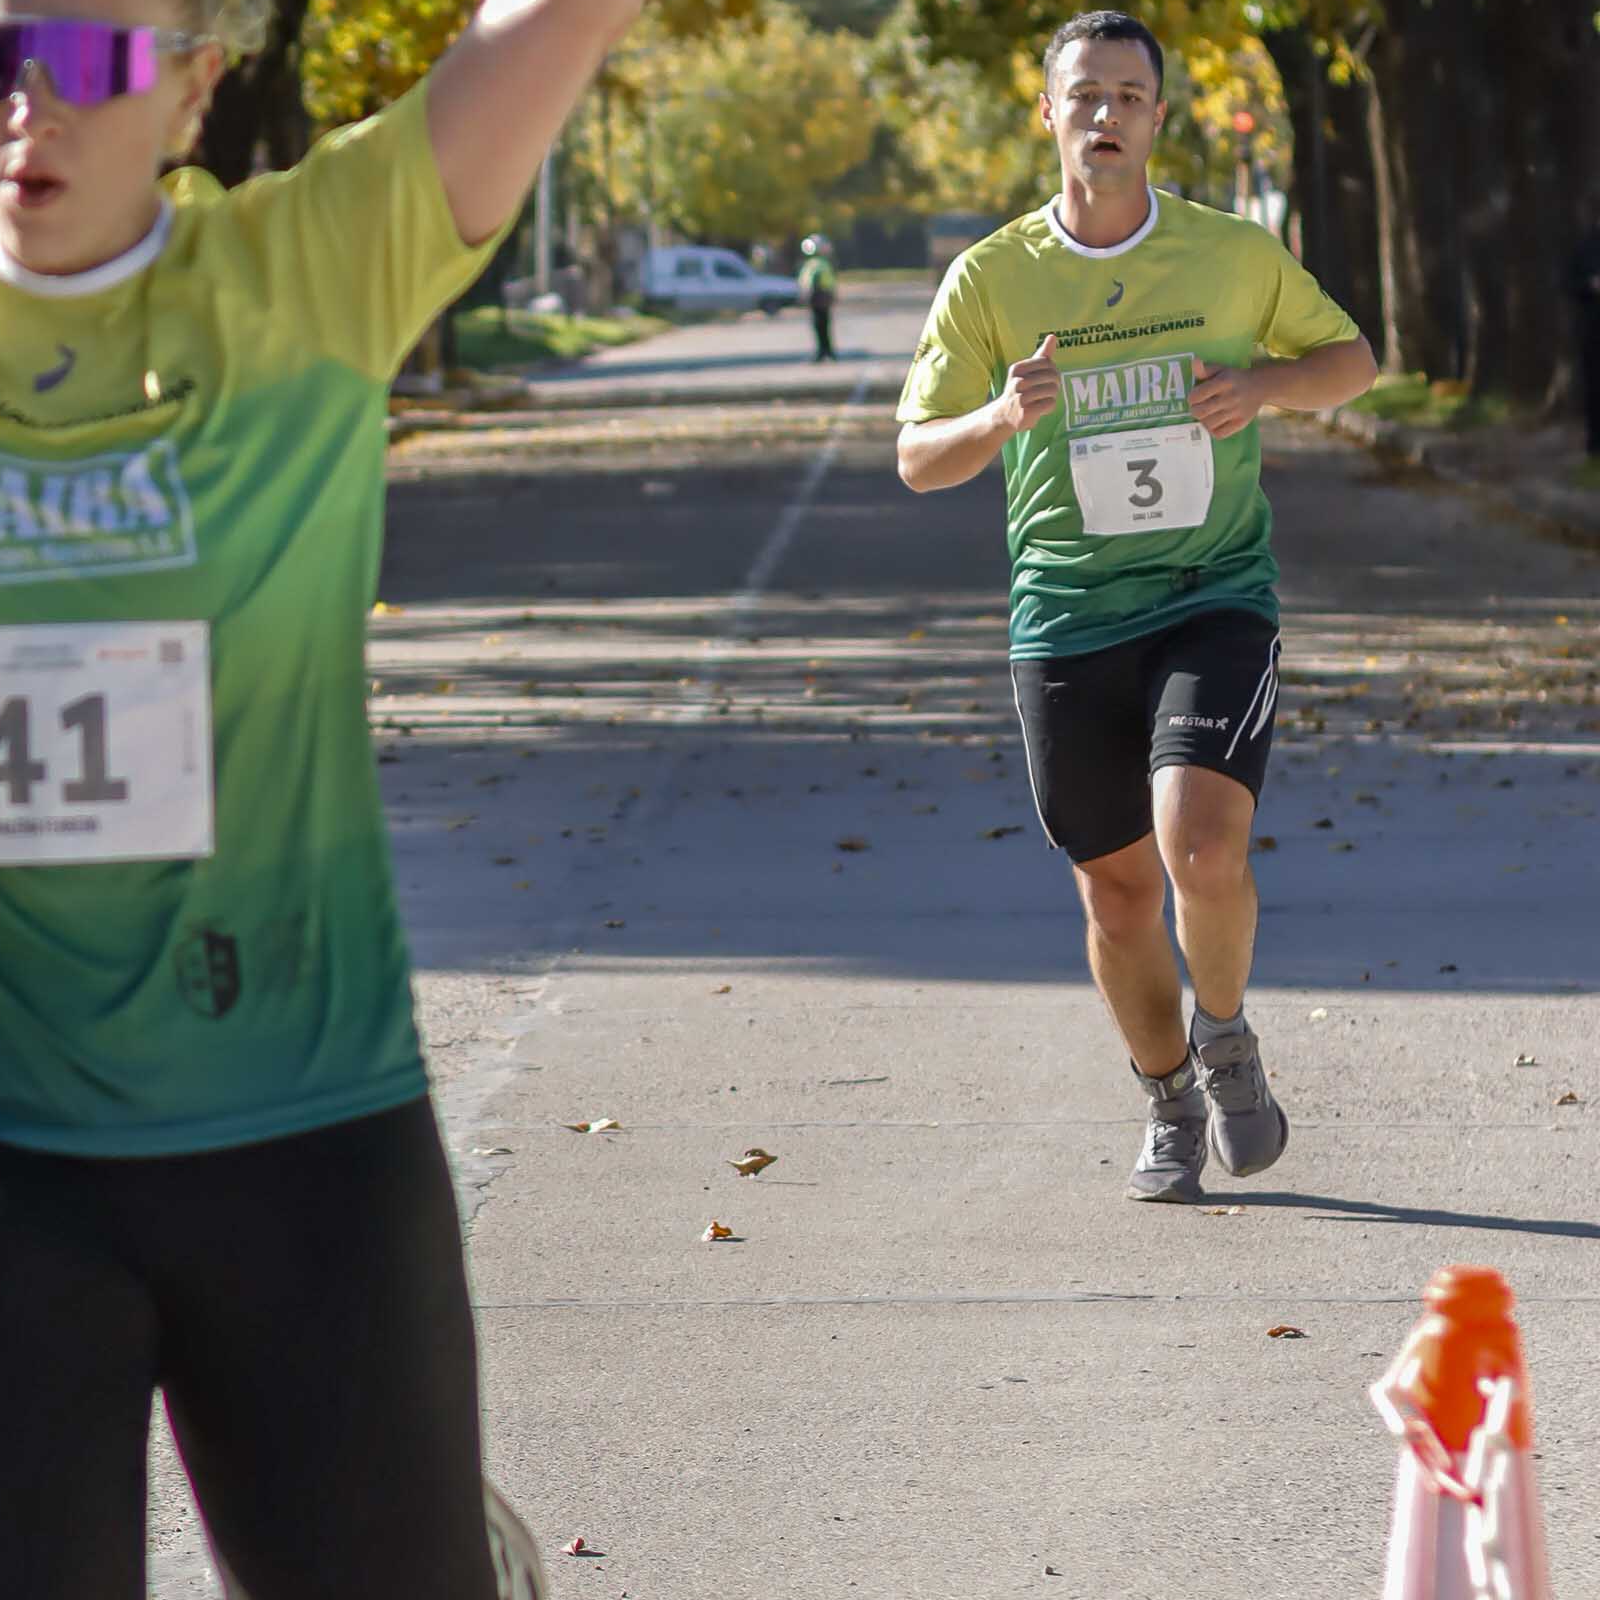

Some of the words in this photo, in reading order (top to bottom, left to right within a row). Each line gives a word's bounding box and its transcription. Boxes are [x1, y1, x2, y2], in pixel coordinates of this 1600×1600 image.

[1071, 361, 1186, 412] MAIRA
[1127, 458, 1163, 507] 3
[1168, 715, 1214, 729] PROSTAR
